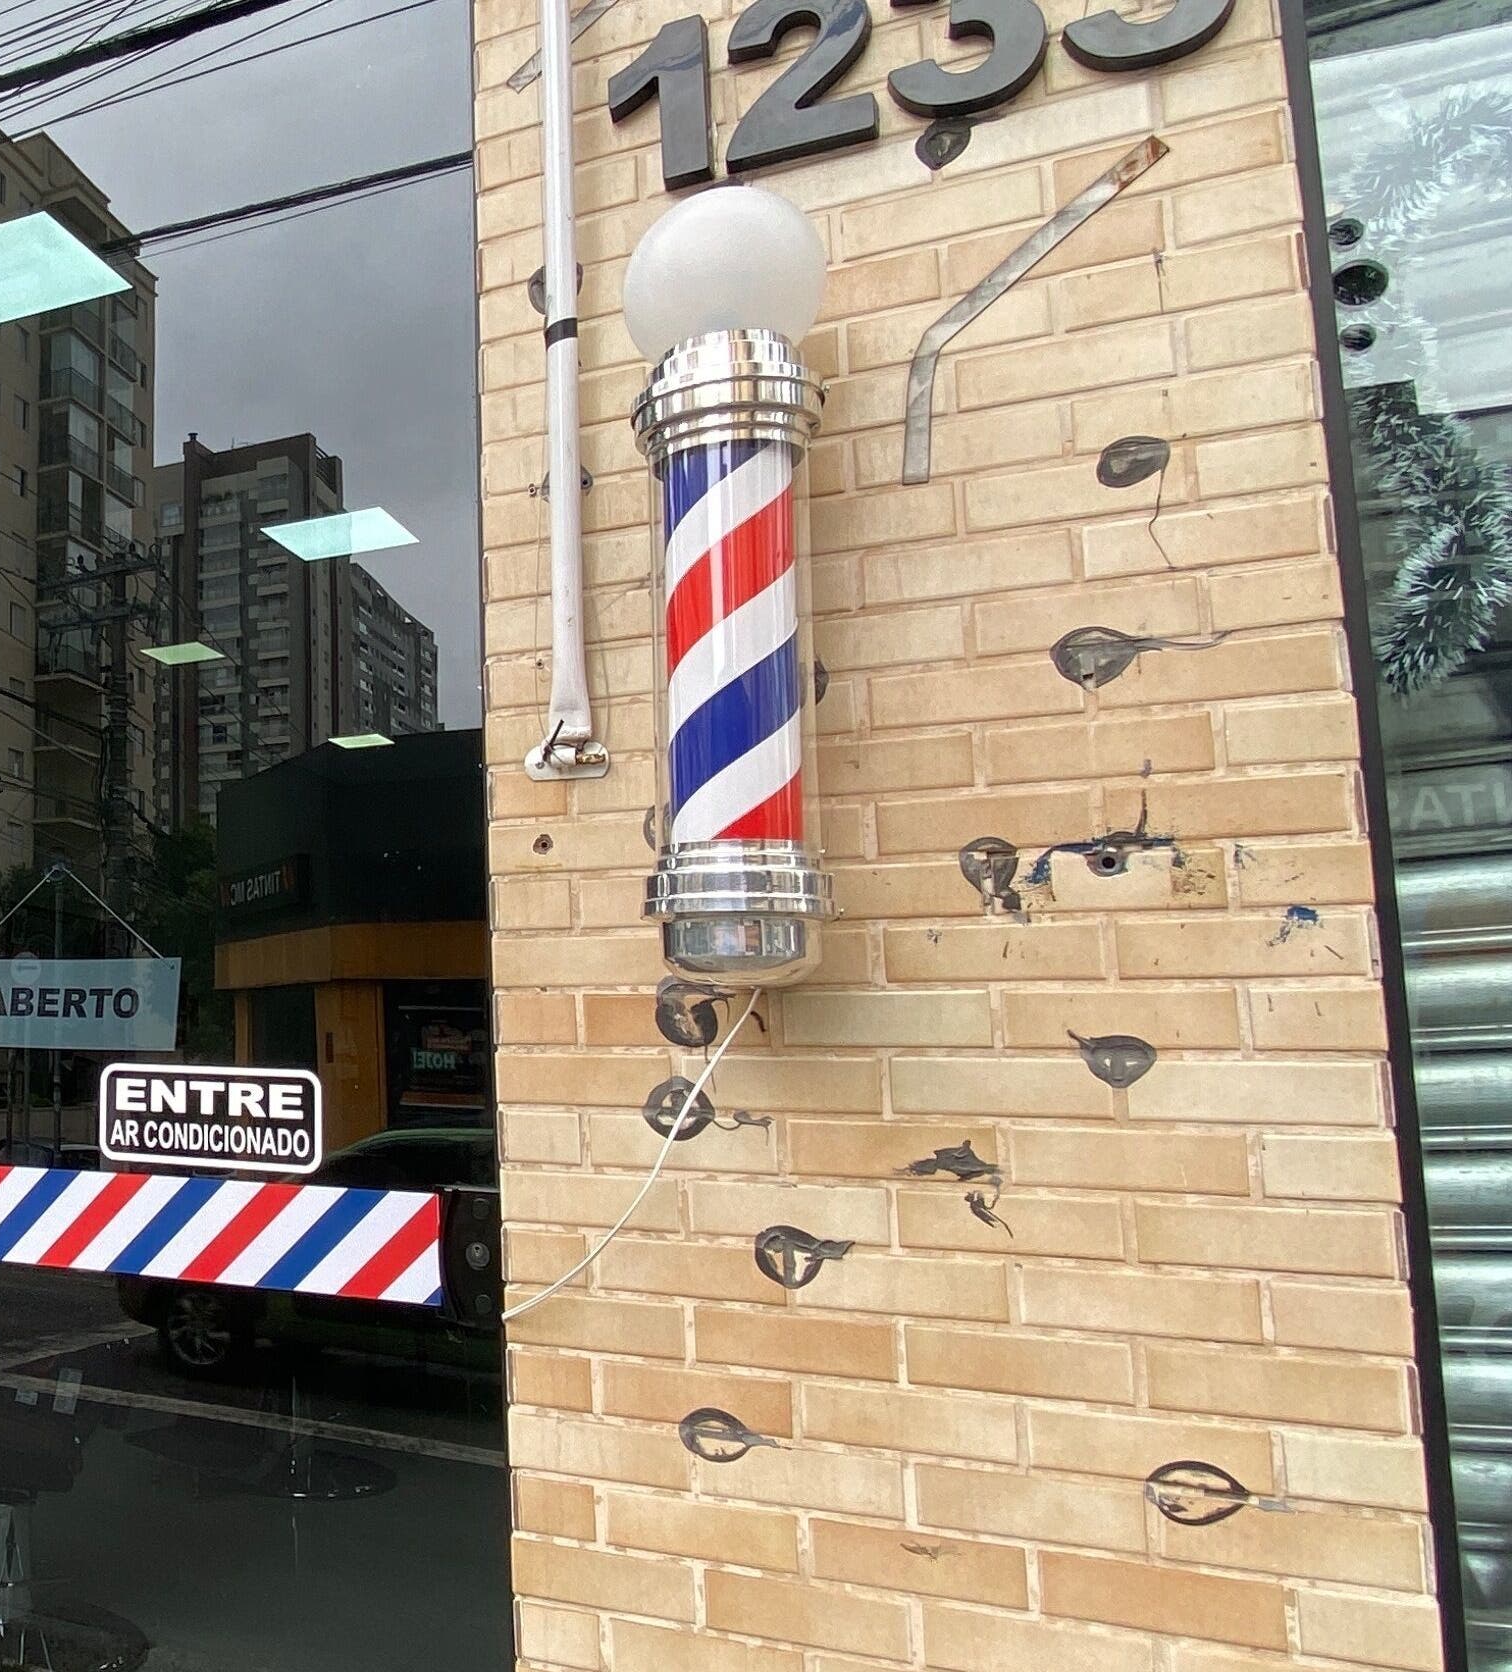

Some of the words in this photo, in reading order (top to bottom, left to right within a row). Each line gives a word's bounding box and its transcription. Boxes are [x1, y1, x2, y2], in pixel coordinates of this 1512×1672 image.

[115, 1077, 304, 1120] ENTRE
[110, 1119, 139, 1147] AR
[143, 1120, 310, 1158] CONDICIONADO
